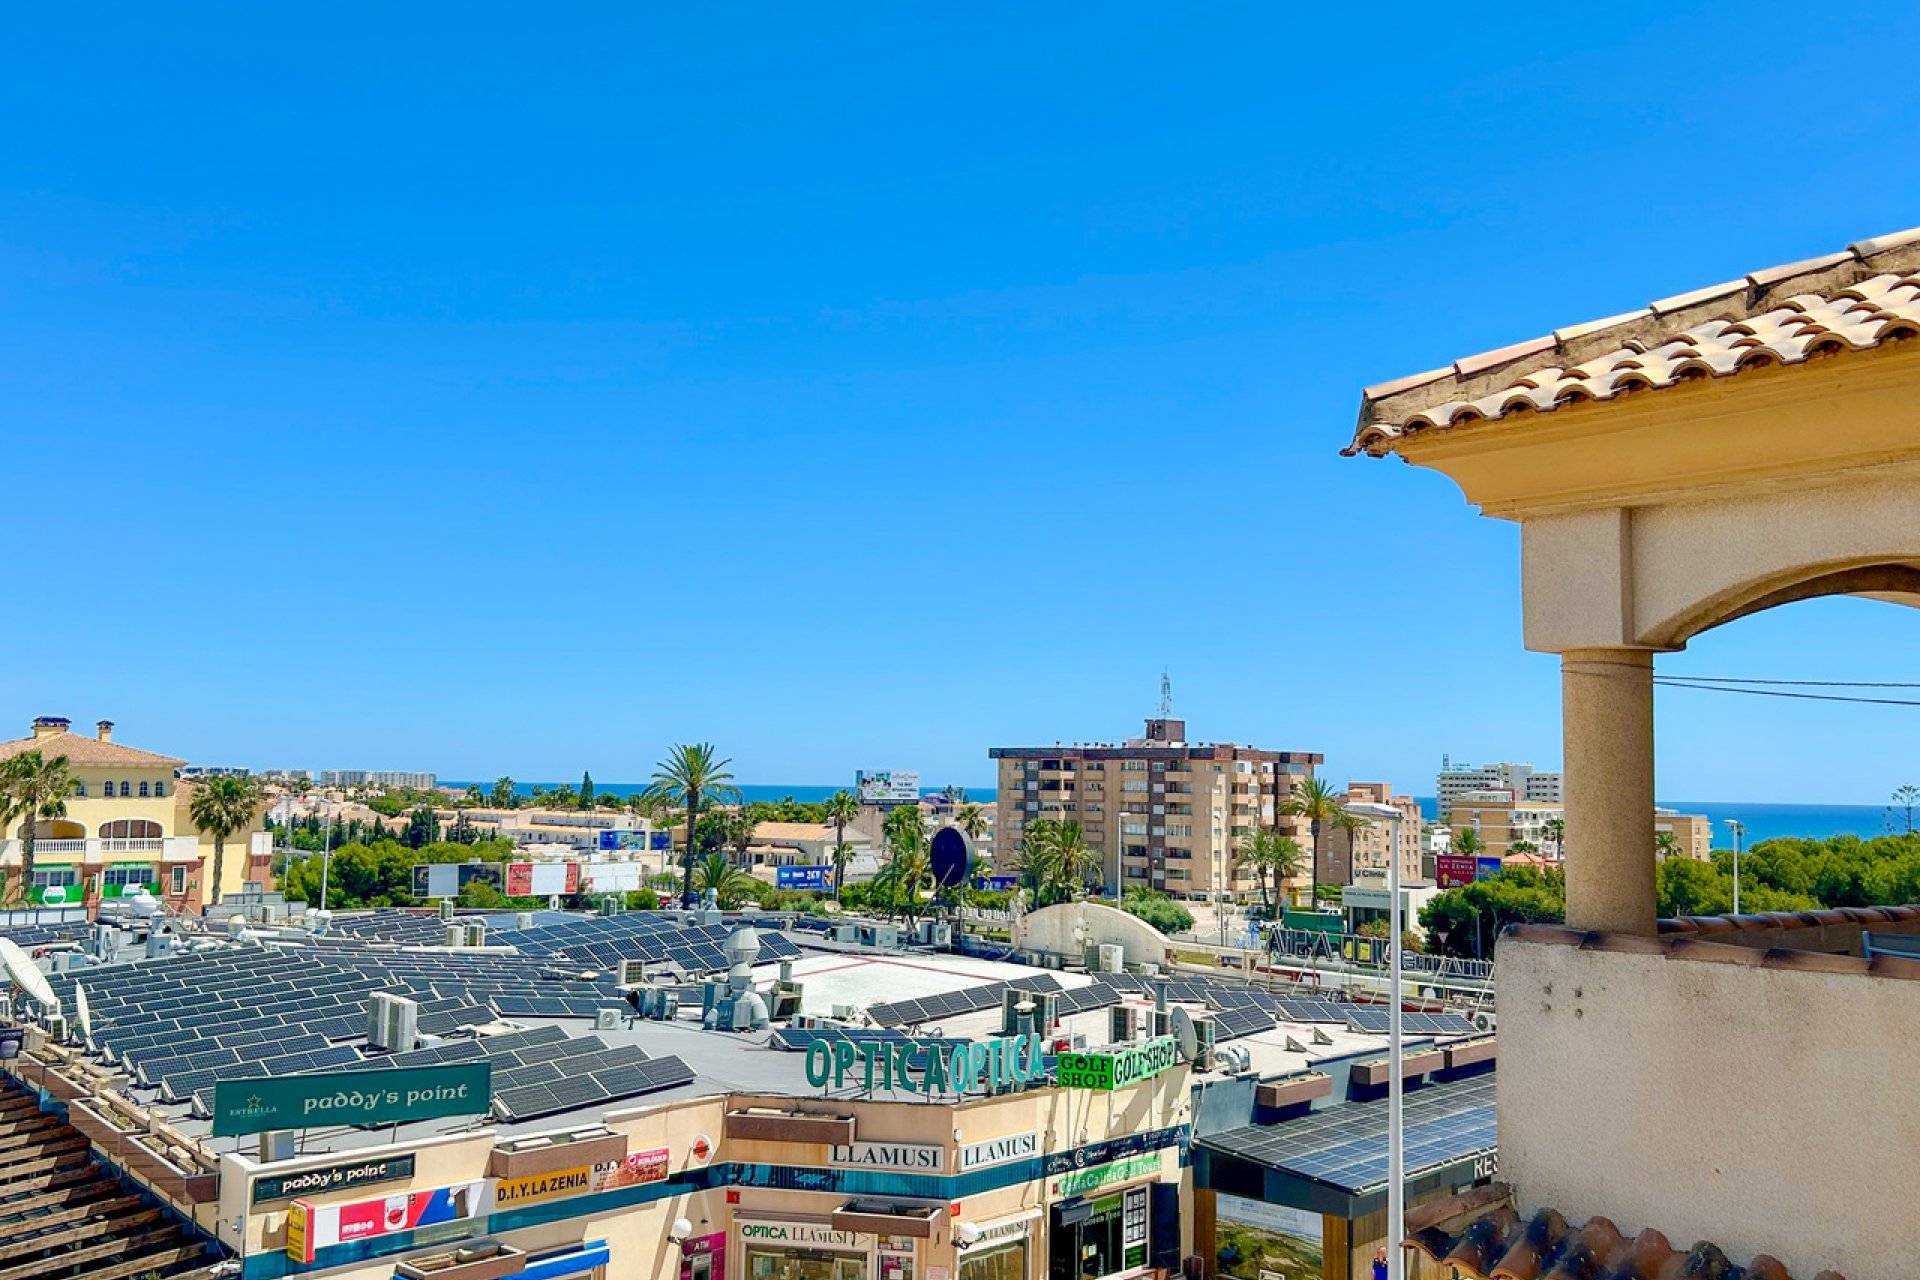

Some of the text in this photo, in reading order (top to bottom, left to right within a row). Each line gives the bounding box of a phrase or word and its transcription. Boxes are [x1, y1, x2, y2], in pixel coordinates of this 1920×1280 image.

[805, 1038, 946, 1093] OPTICA
[950, 1032, 1045, 1092] OPTICA
[1061, 1055, 1111, 1072] GOLF
[1061, 1072, 1108, 1088] SHOP
[303, 1083, 468, 1115] paddy's point
[833, 1144, 938, 1168] LLAMUSI
[964, 1134, 1036, 1166] LLAMUSI
[282, 1163, 386, 1193] paddy's point
[550, 1172, 588, 1191] ZENIA
[742, 1224, 847, 1244] OPTICA LLAMUSI
